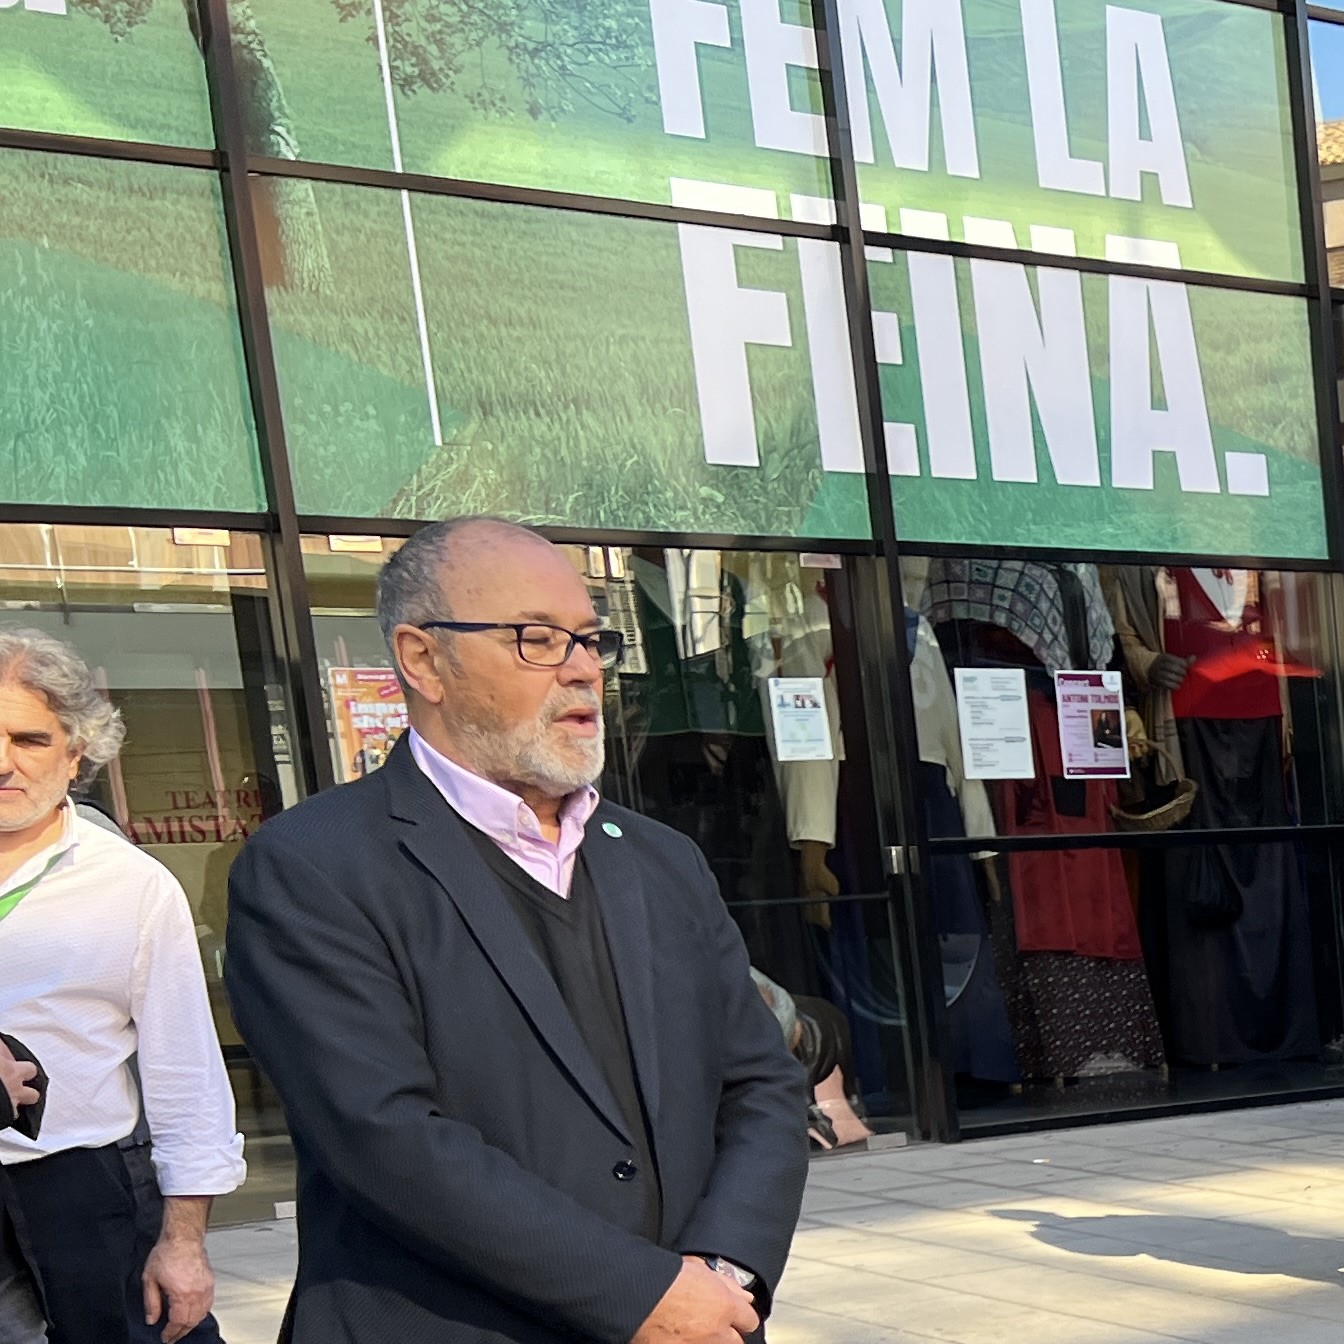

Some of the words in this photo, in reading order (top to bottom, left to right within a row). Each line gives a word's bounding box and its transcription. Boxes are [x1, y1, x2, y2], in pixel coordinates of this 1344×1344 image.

[650, 0, 980, 179] FEM
[1021, 0, 1193, 208] LA
[670, 177, 1269, 496] FEINA.
